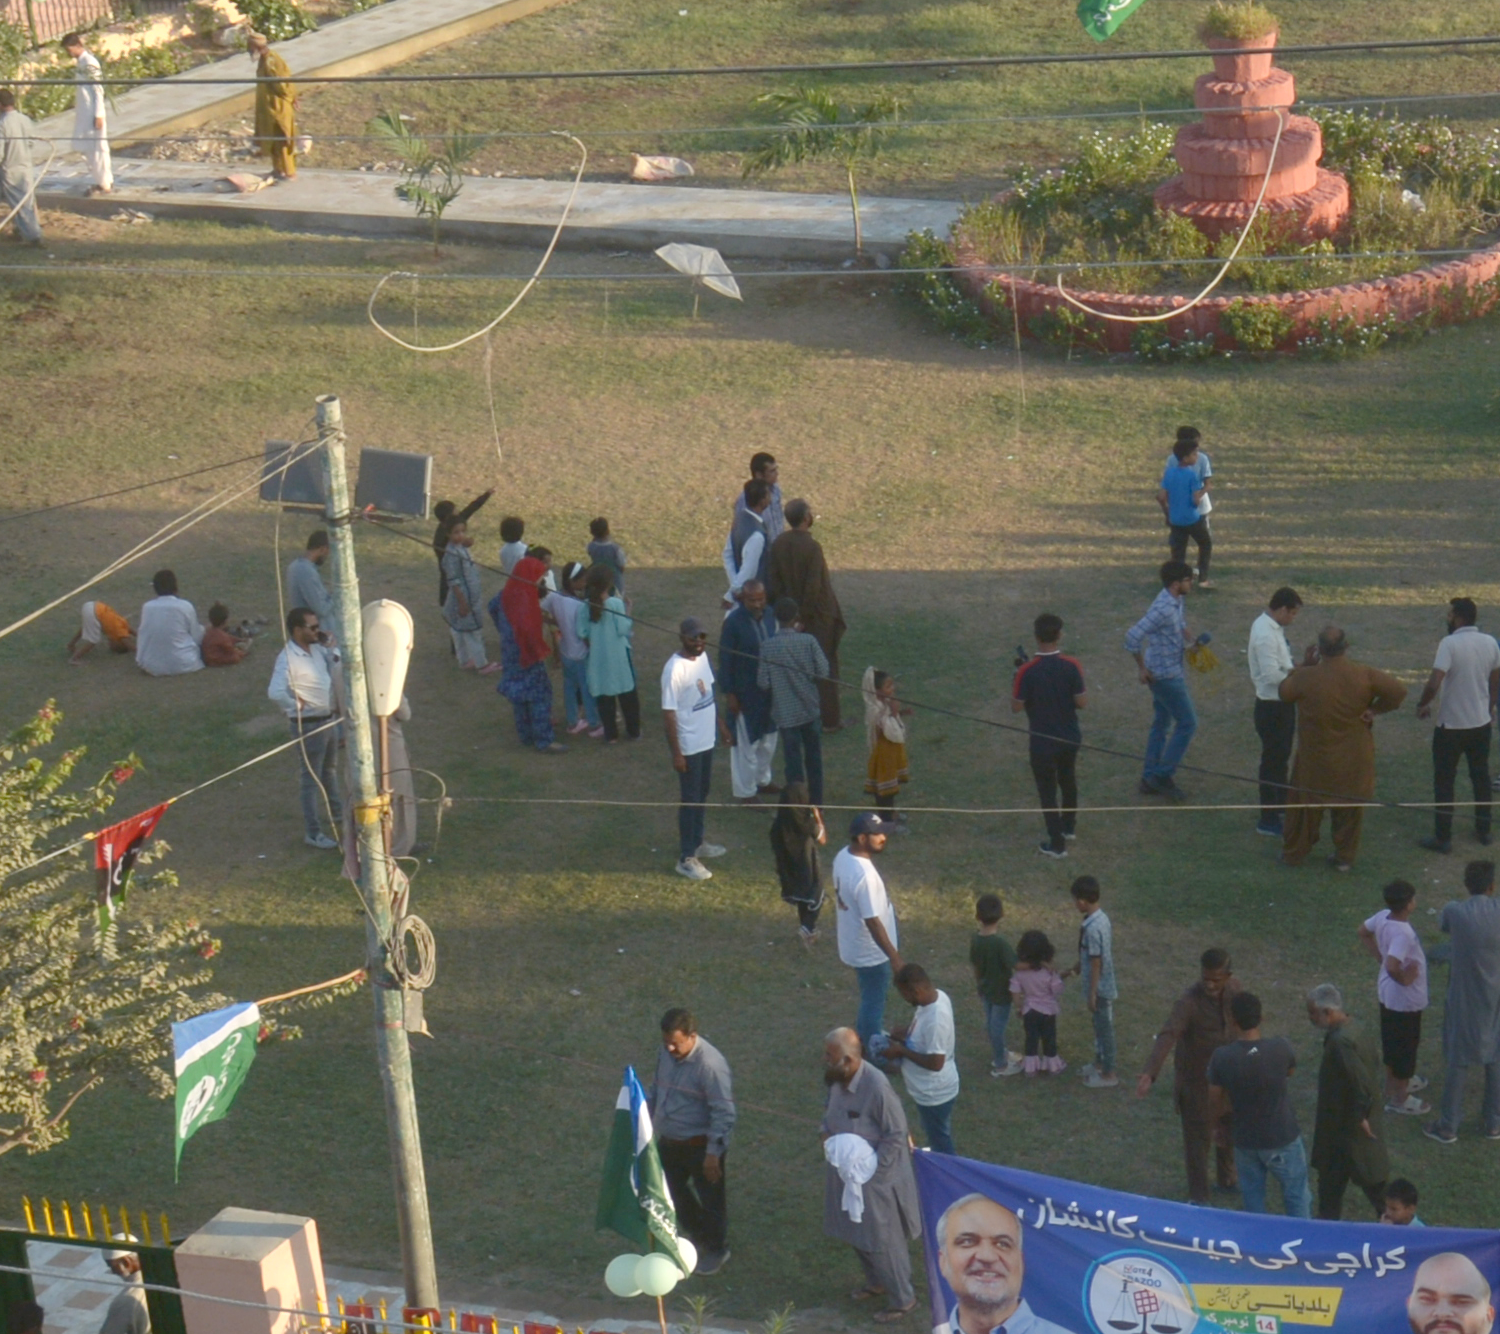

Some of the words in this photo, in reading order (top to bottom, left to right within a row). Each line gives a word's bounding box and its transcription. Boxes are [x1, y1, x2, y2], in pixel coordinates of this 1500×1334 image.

[1138, 1225, 1244, 1264] جیت
[1248, 1239, 1304, 1269] کی
[1304, 1242, 1407, 1278] کراچی
[1247, 1293, 1331, 1320] بلدیاتی
[1256, 1318, 1275, 1332] 14
